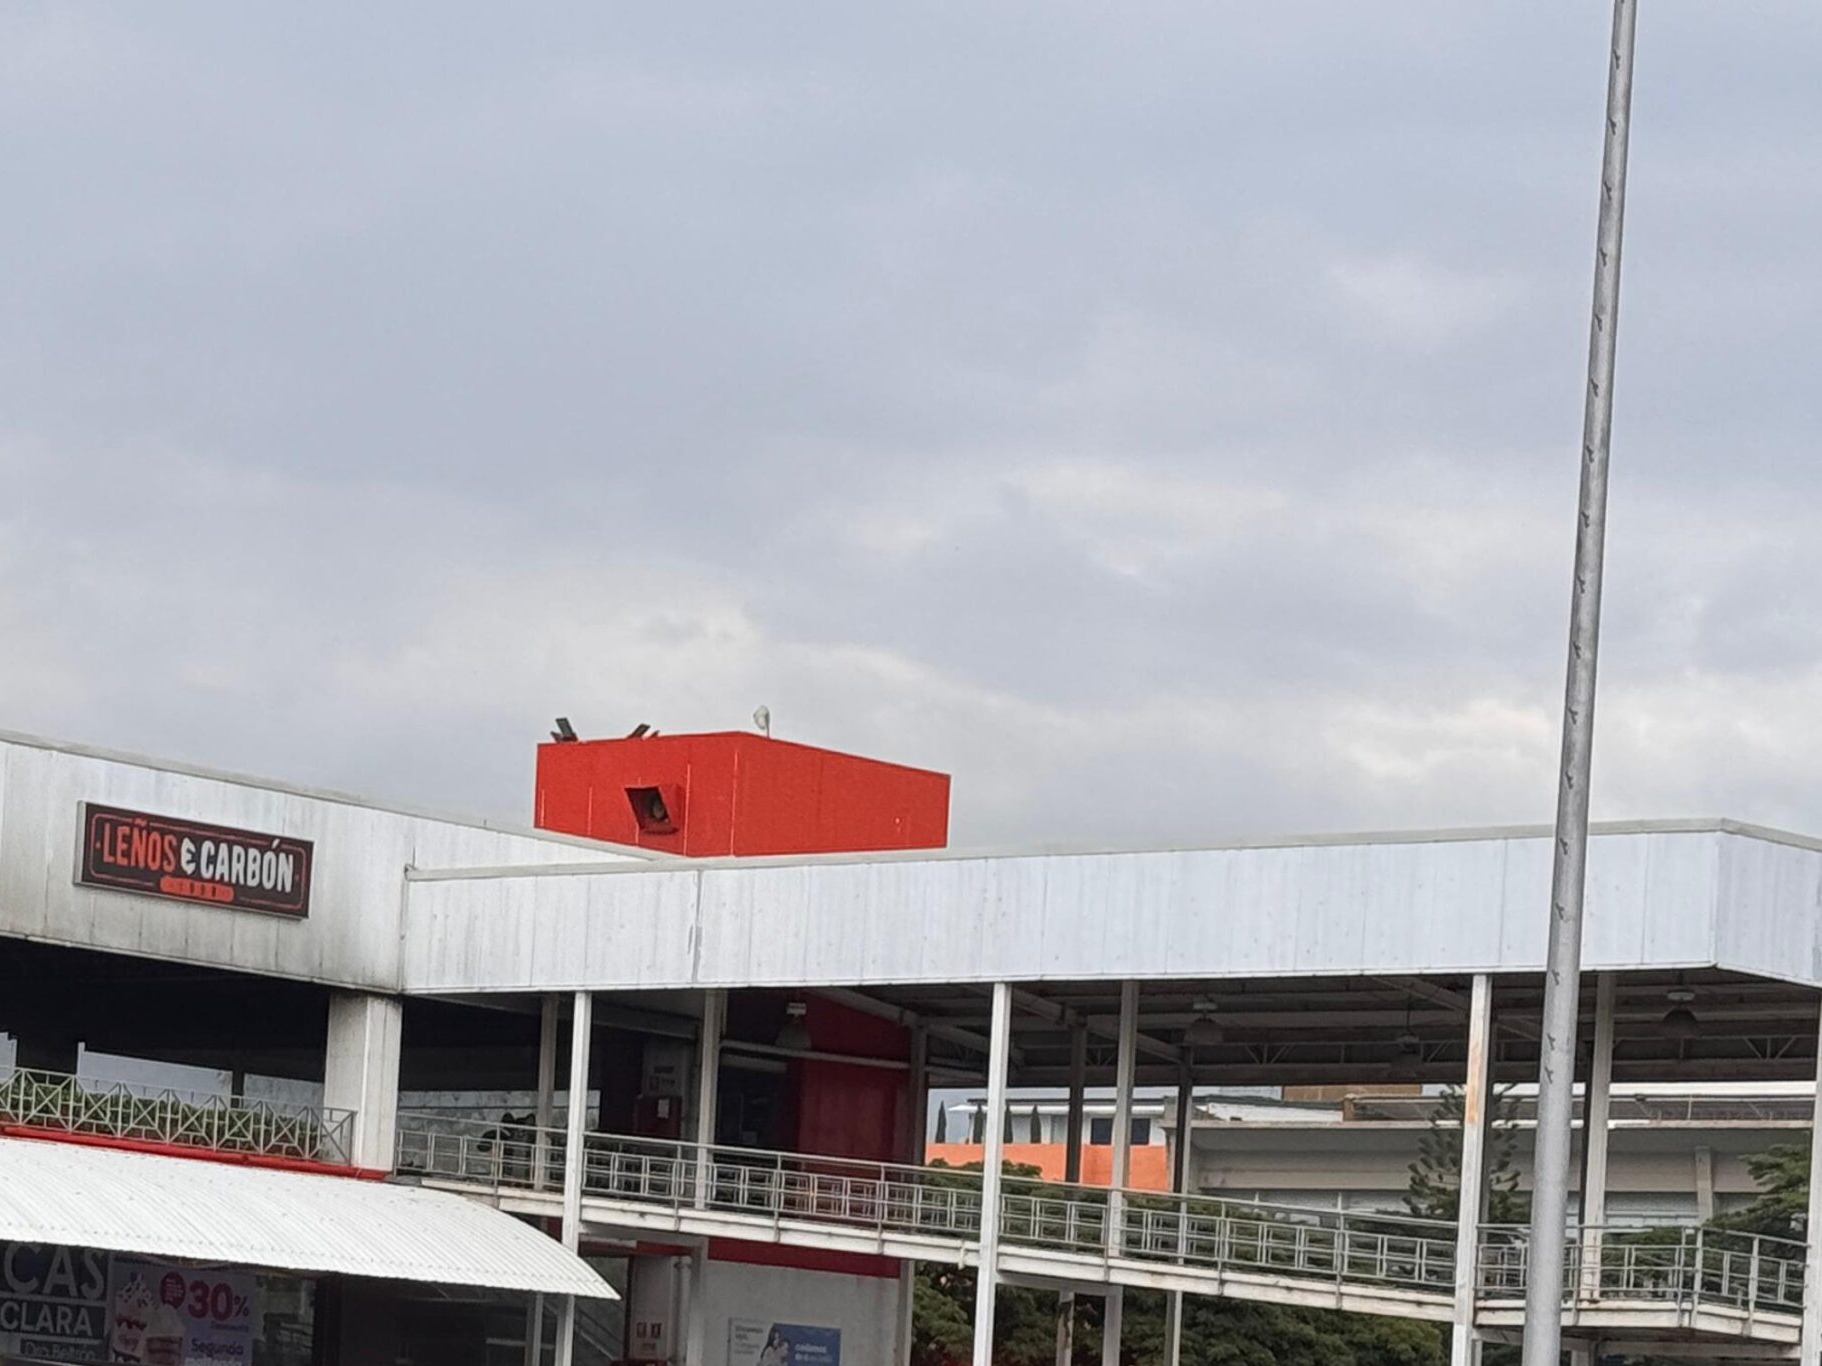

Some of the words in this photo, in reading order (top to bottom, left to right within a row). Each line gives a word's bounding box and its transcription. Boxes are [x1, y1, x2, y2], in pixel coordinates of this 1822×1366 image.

[102, 817, 178, 874] LEÑOS
[200, 838, 296, 895] CARBÓN
[0, 1300, 94, 1338] CLARA
